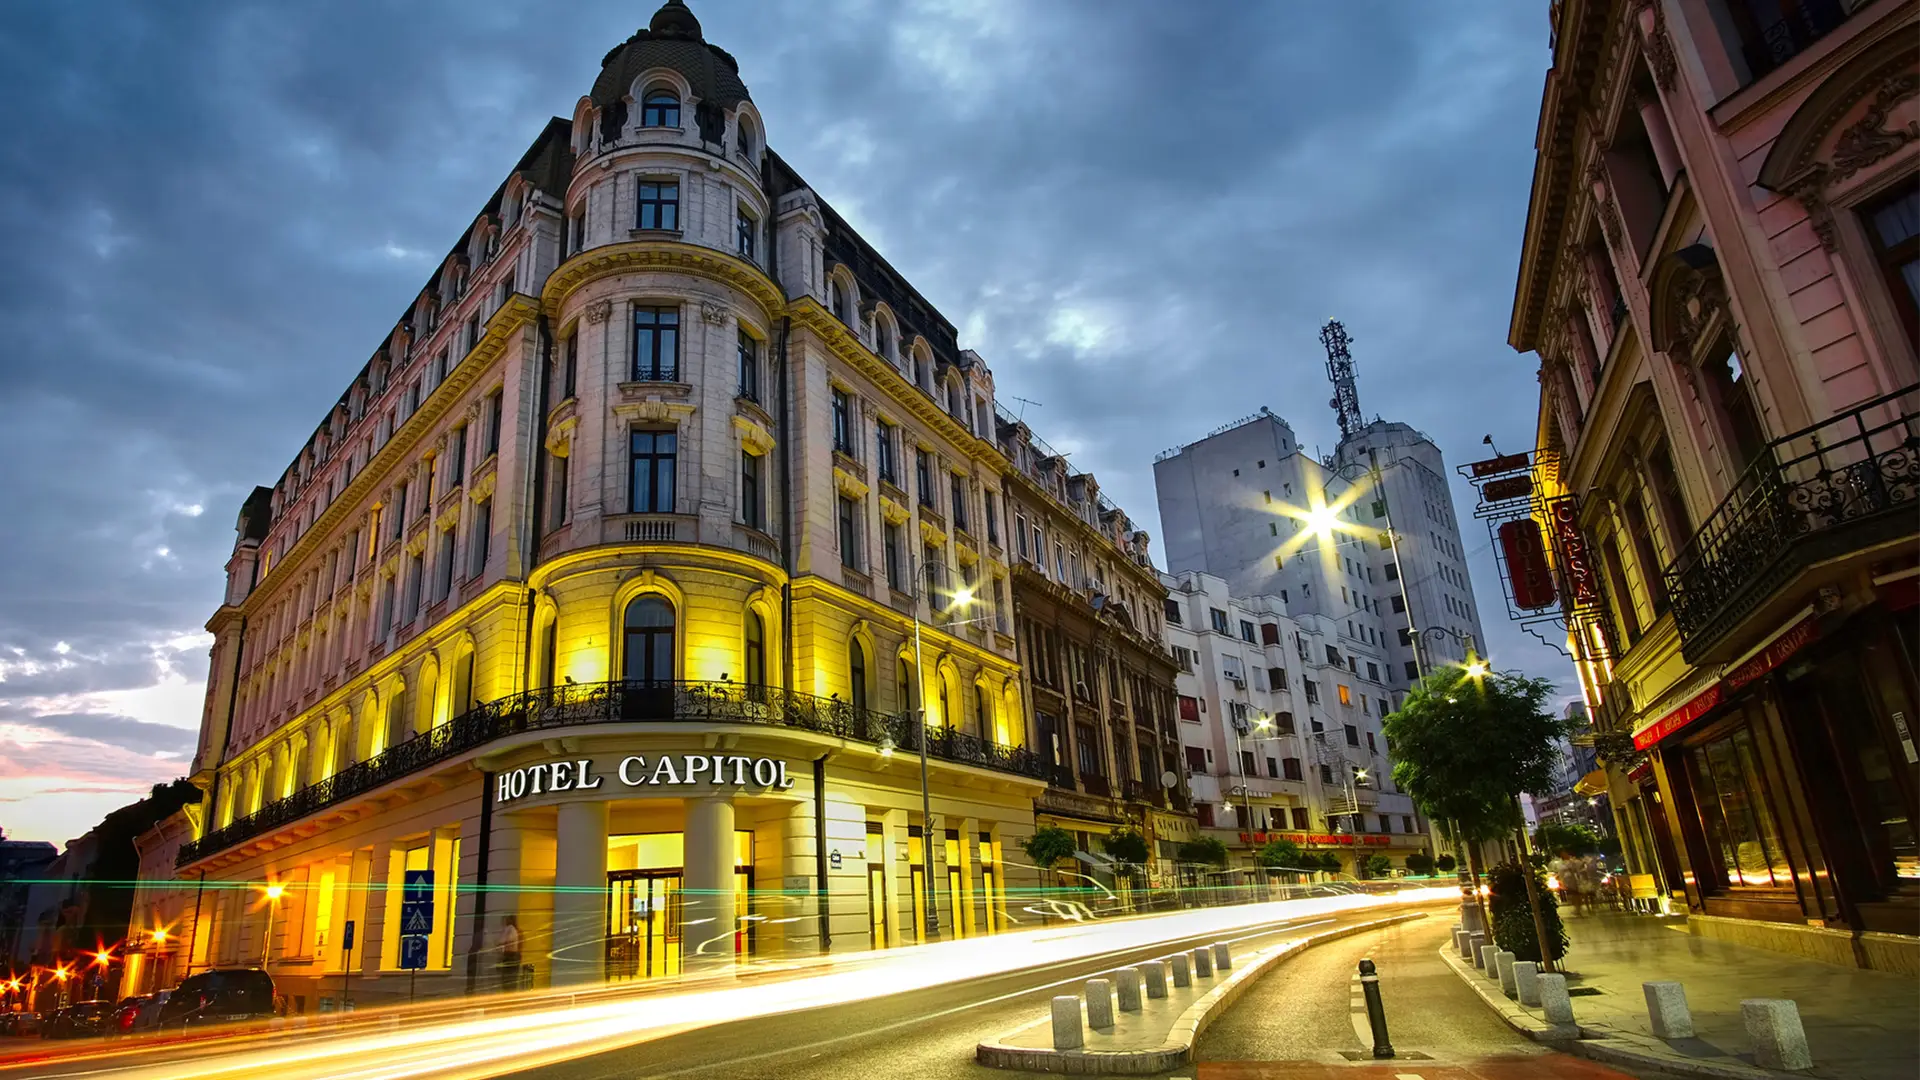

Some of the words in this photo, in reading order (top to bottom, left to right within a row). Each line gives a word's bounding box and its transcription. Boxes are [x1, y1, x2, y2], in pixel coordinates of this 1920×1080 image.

[1557, 506, 1596, 600] CAPSA
[497, 760, 602, 802] HOTEL
[618, 755, 796, 788] CAPITOL
[407, 939, 423, 959] P
